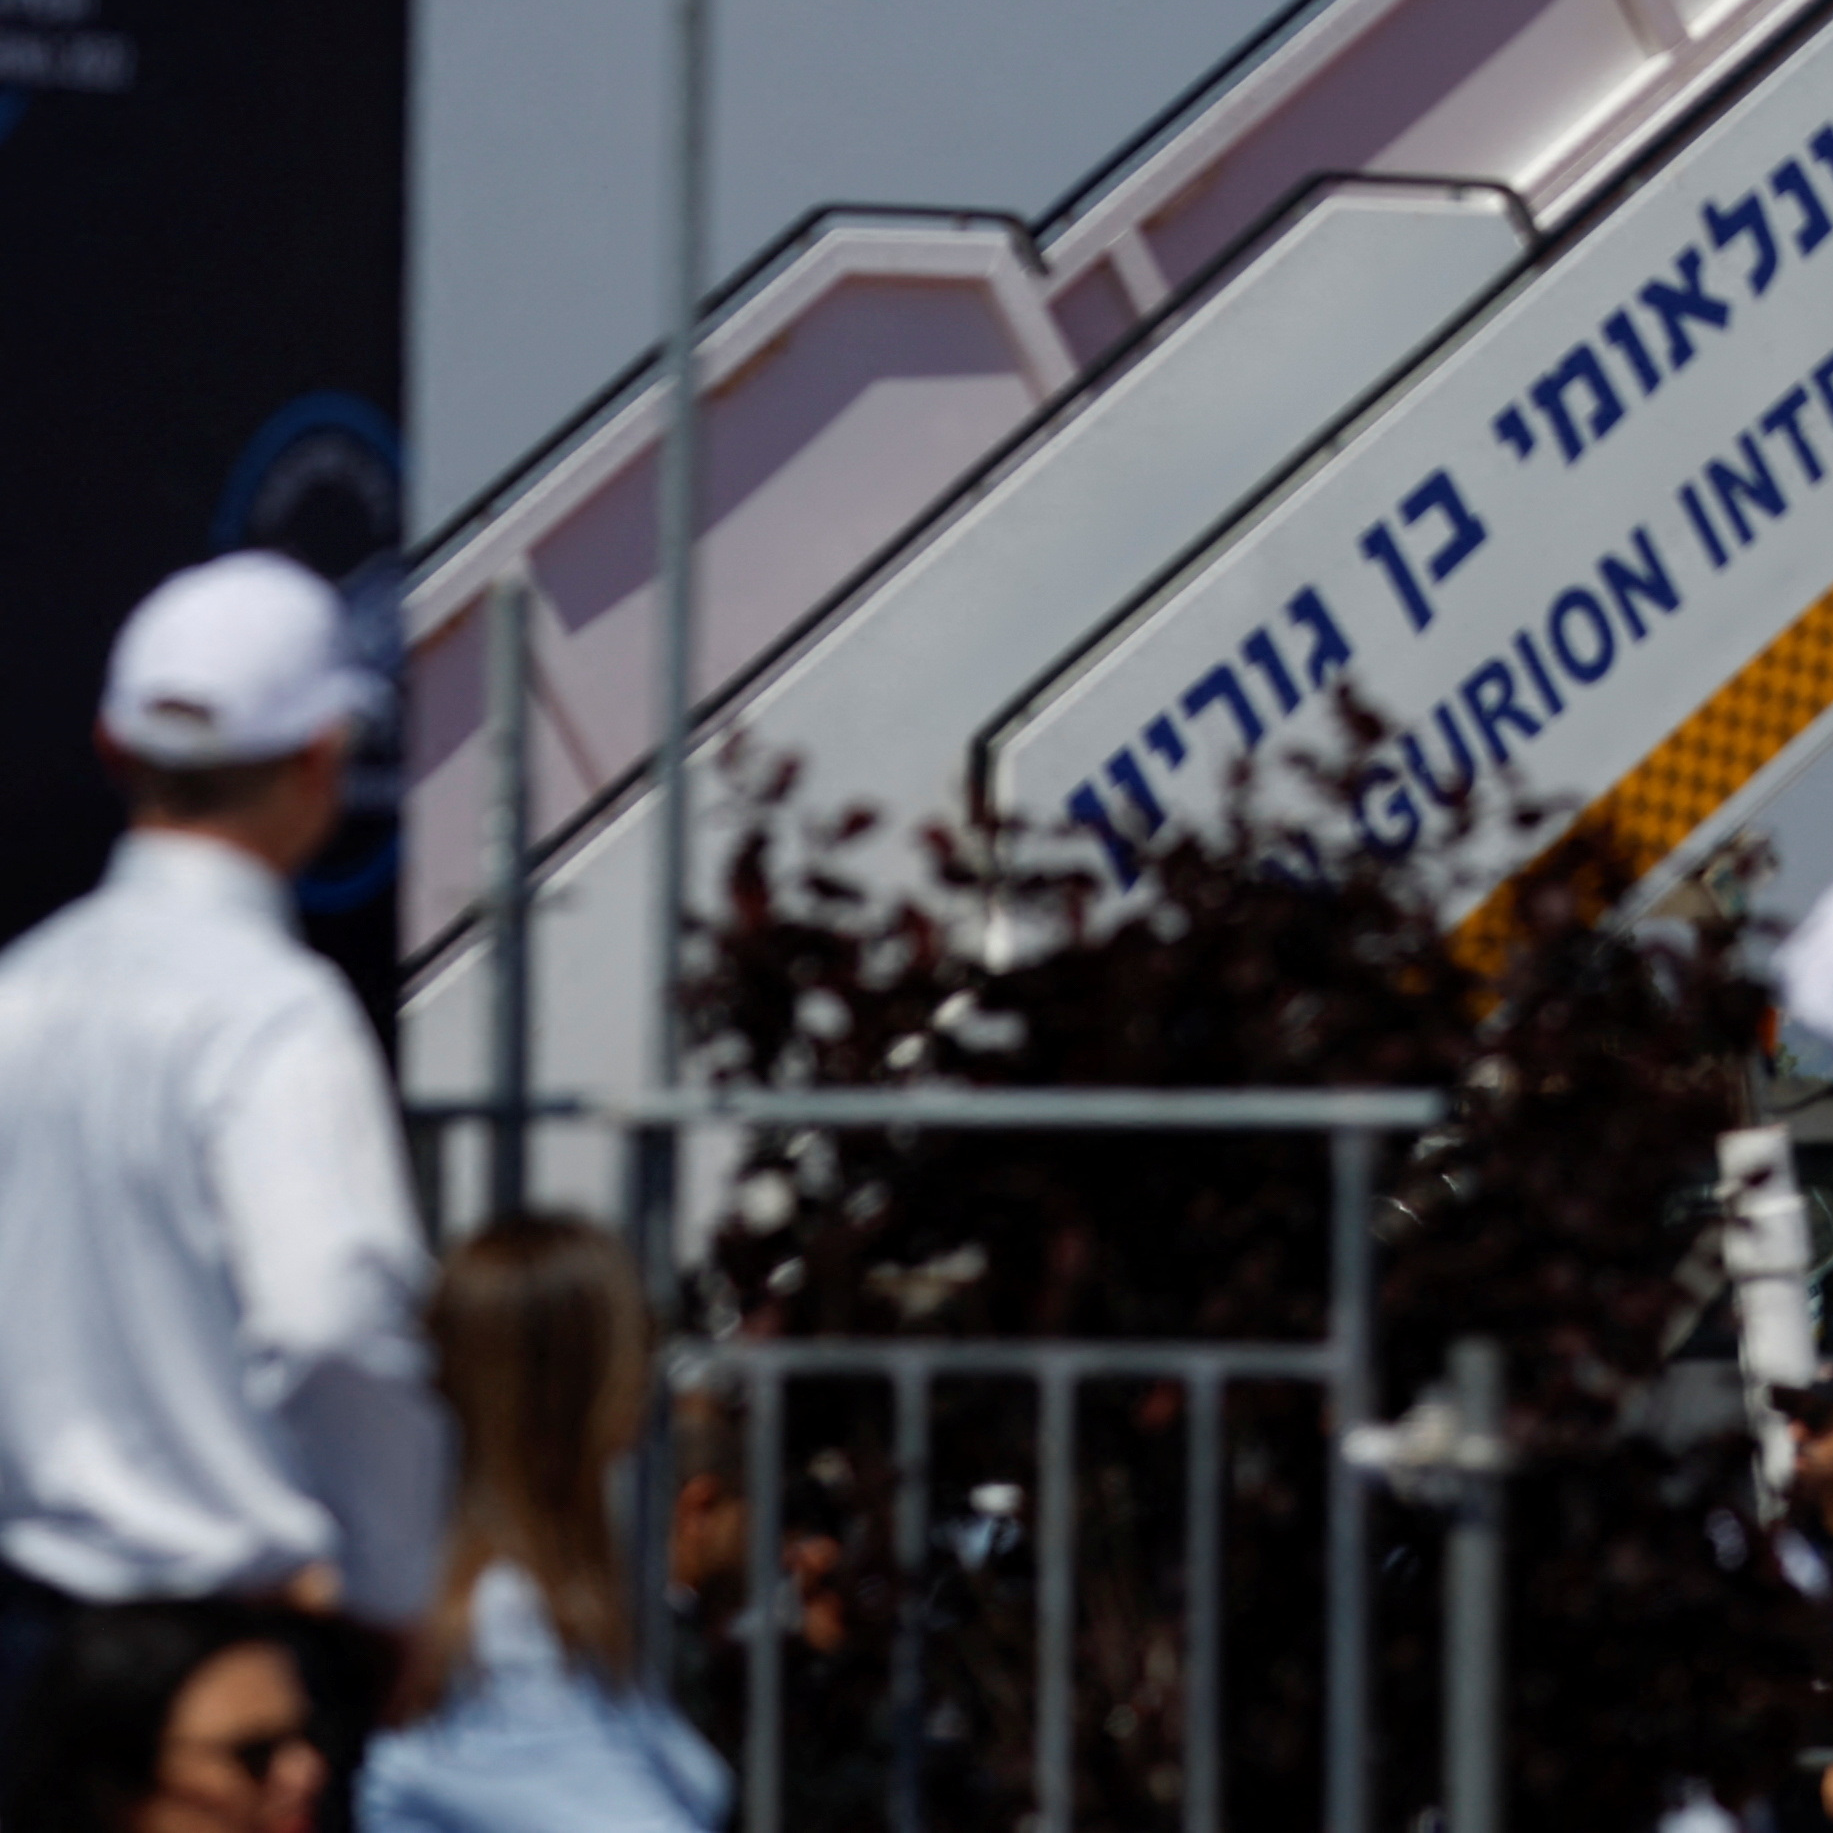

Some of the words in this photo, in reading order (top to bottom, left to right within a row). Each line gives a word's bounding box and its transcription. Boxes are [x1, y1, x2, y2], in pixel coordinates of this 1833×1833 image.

[1352, 522, 1683, 863] GURION
[1357, 467, 1489, 635] בן
[1064, 583, 1355, 894] גוריון
